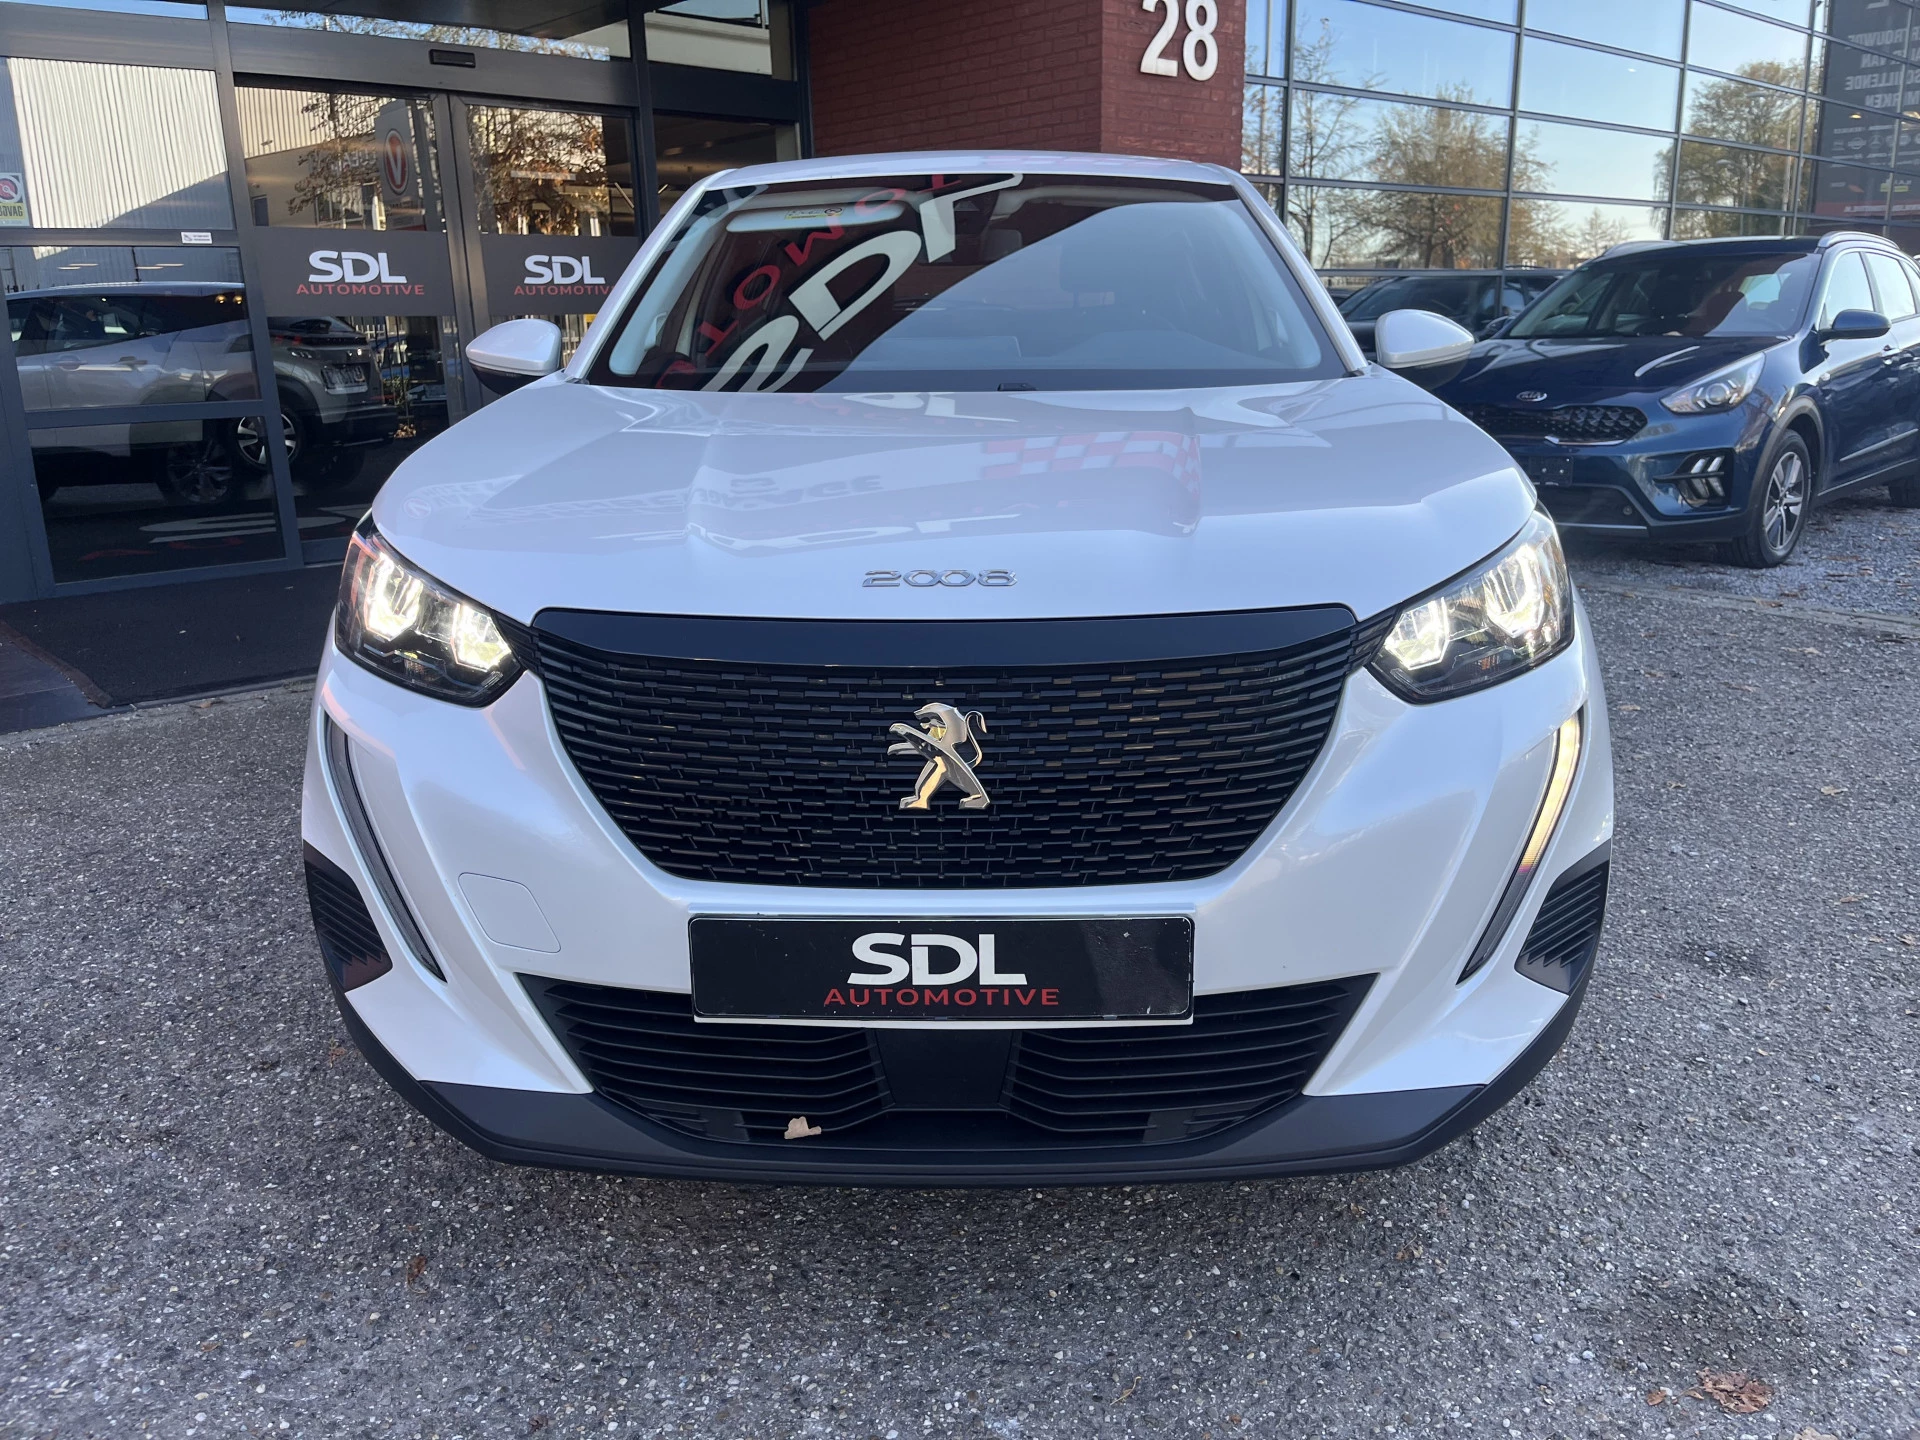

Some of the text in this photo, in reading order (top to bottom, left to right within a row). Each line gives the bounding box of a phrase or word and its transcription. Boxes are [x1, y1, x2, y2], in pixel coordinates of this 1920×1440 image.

[1140, 0, 1218, 80] 28
[308, 250, 408, 283] SDL
[524, 255, 606, 284] SDL
[296, 284, 425, 295] AUTOMOTIVE
[514, 285, 615, 295] AUTOMOTIV
[863, 570, 1018, 587] 2008
[848, 932, 1028, 985] SDL
[824, 989, 1059, 1005] AUTOMOTIVE
